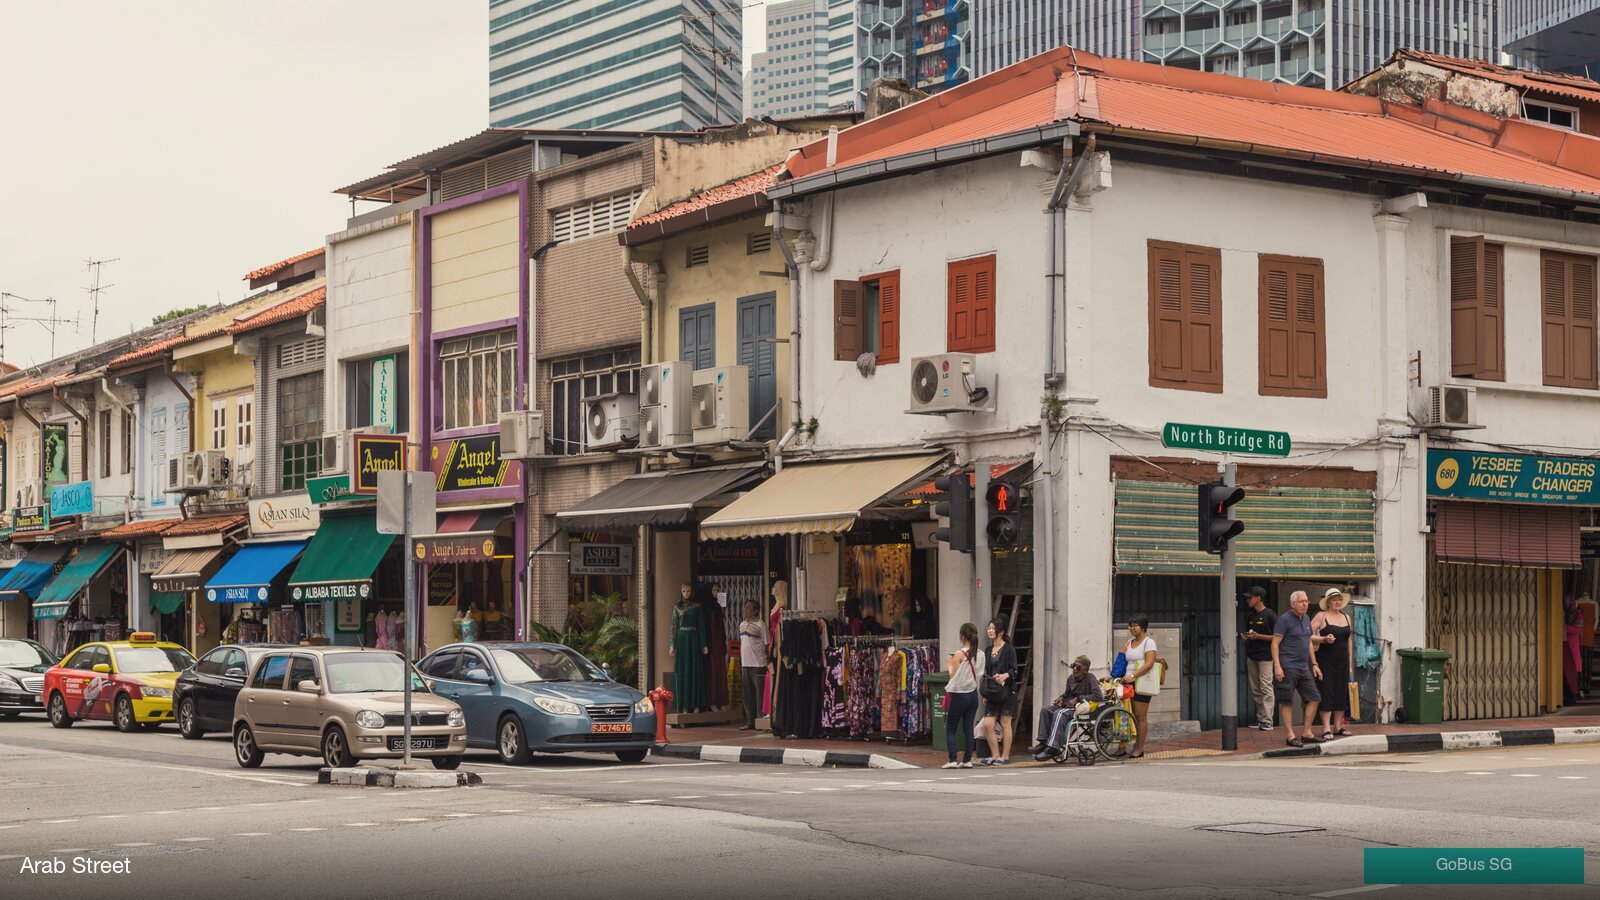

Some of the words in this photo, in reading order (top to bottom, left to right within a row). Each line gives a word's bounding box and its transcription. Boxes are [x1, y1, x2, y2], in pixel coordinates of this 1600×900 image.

[1171, 426, 1212, 444] North
[1218, 430, 1262, 451] Bridge
[1268, 434, 1284, 450] Rd
[457, 441, 495, 474] Angel
[1439, 468, 1455, 479] 680
[1471, 456, 1522, 472] YESBEE
[1537, 460, 1596, 477] TRADERS
[1468, 473, 1518, 488] MONEY
[1532, 477, 1593, 493] CHANGER
[61, 489, 80, 507] JASCO
[263, 509, 288, 521] ASIAN
[289, 507, 310, 520] SILQ
[432, 541, 454, 560] Angel
[588, 548, 617, 557] ASHER
[305, 586, 329, 599] ALIBABA
[330, 585, 357, 597] TEXTILES
[592, 724, 631, 732] SJC7467G
[393, 740, 433, 749] SG297U
